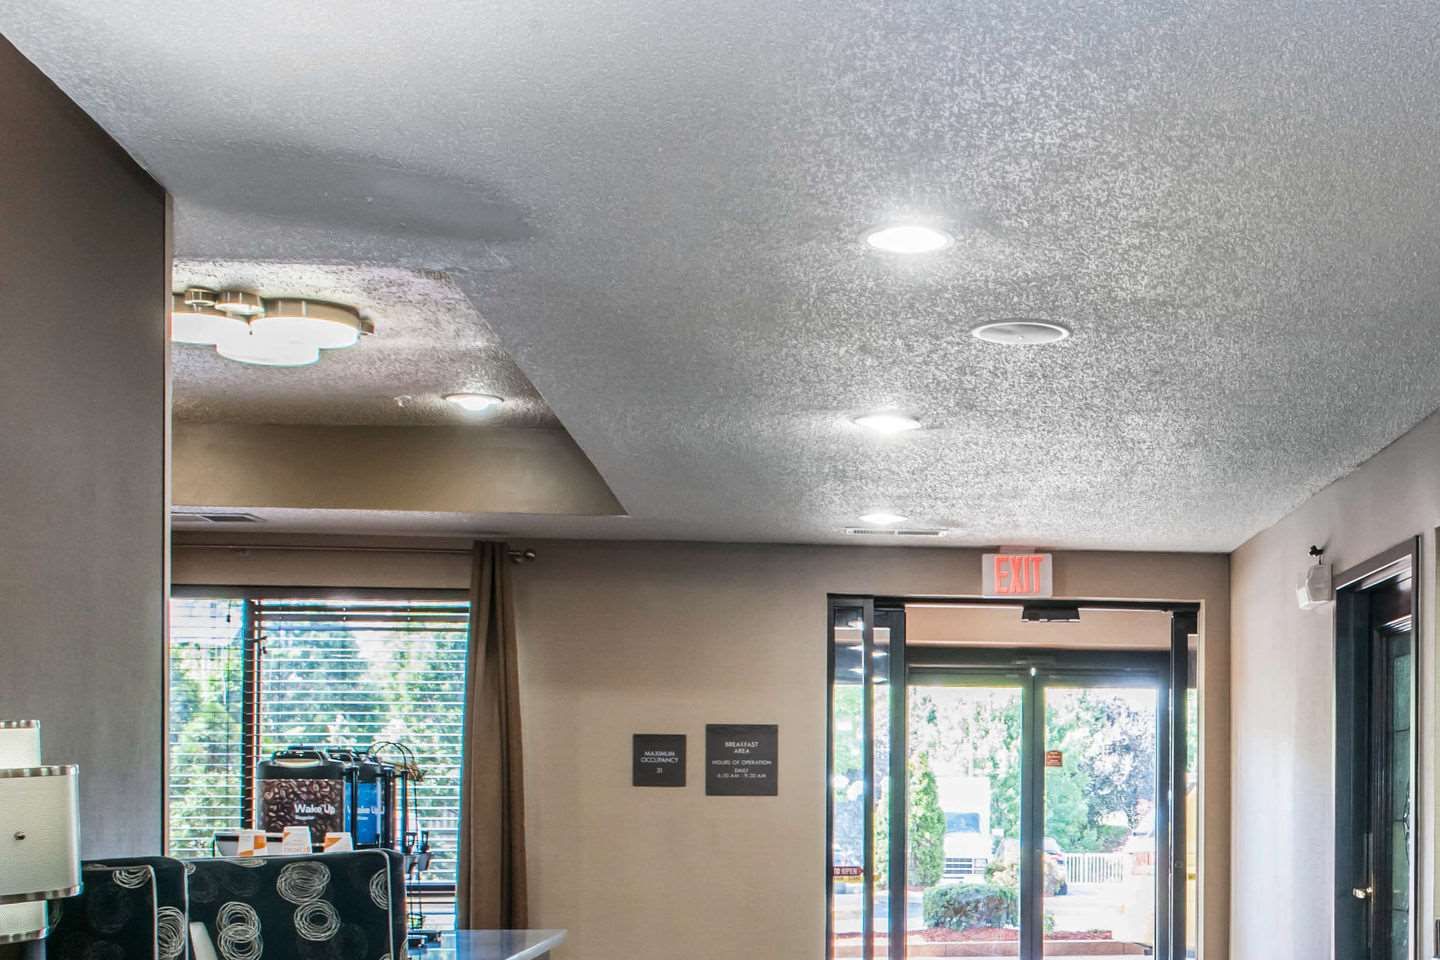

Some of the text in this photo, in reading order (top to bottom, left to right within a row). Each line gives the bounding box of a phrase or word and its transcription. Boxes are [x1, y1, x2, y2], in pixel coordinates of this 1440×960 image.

[994, 556, 1041, 593] EXIT
[294, 803, 336, 815] Wake Up
